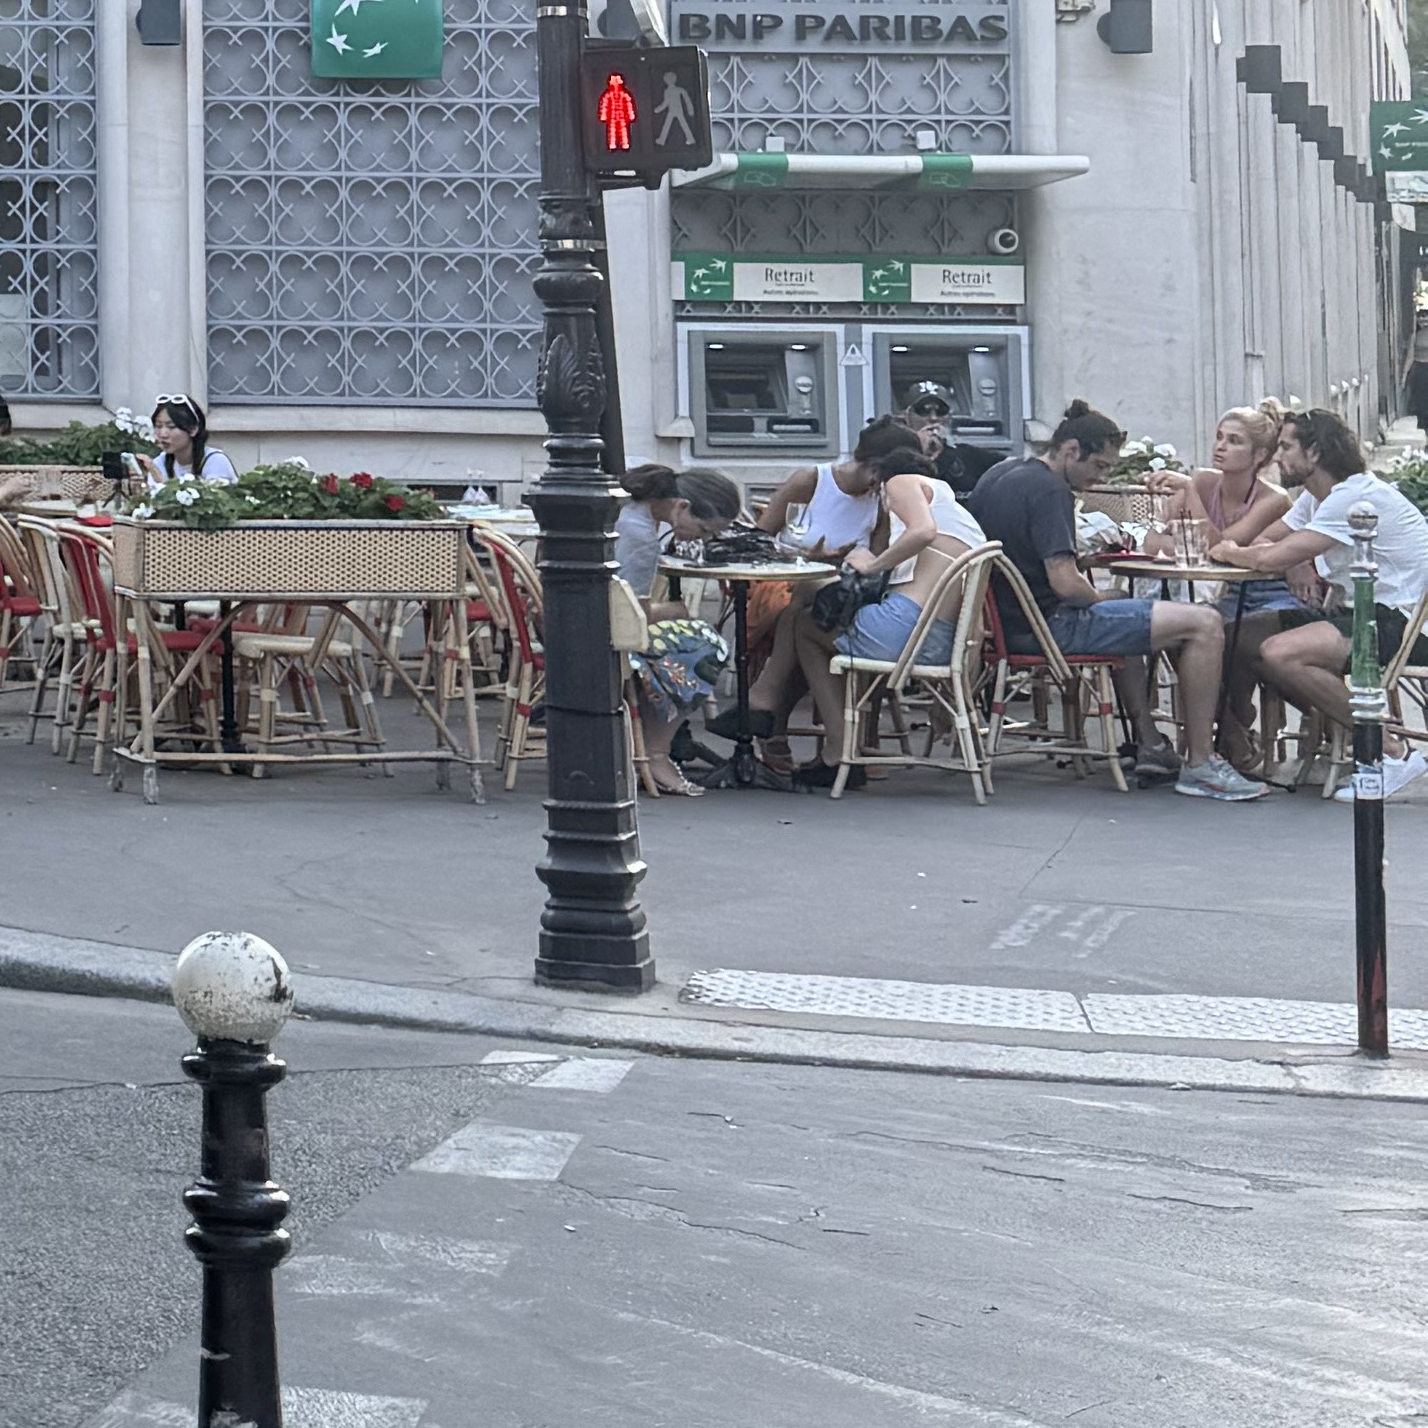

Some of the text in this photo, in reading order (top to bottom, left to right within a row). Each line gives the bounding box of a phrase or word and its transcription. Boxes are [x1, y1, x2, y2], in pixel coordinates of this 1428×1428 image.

[678, 13, 1008, 42] BNP PARIBAS
[765, 267, 993, 284] Retrait Retrait
